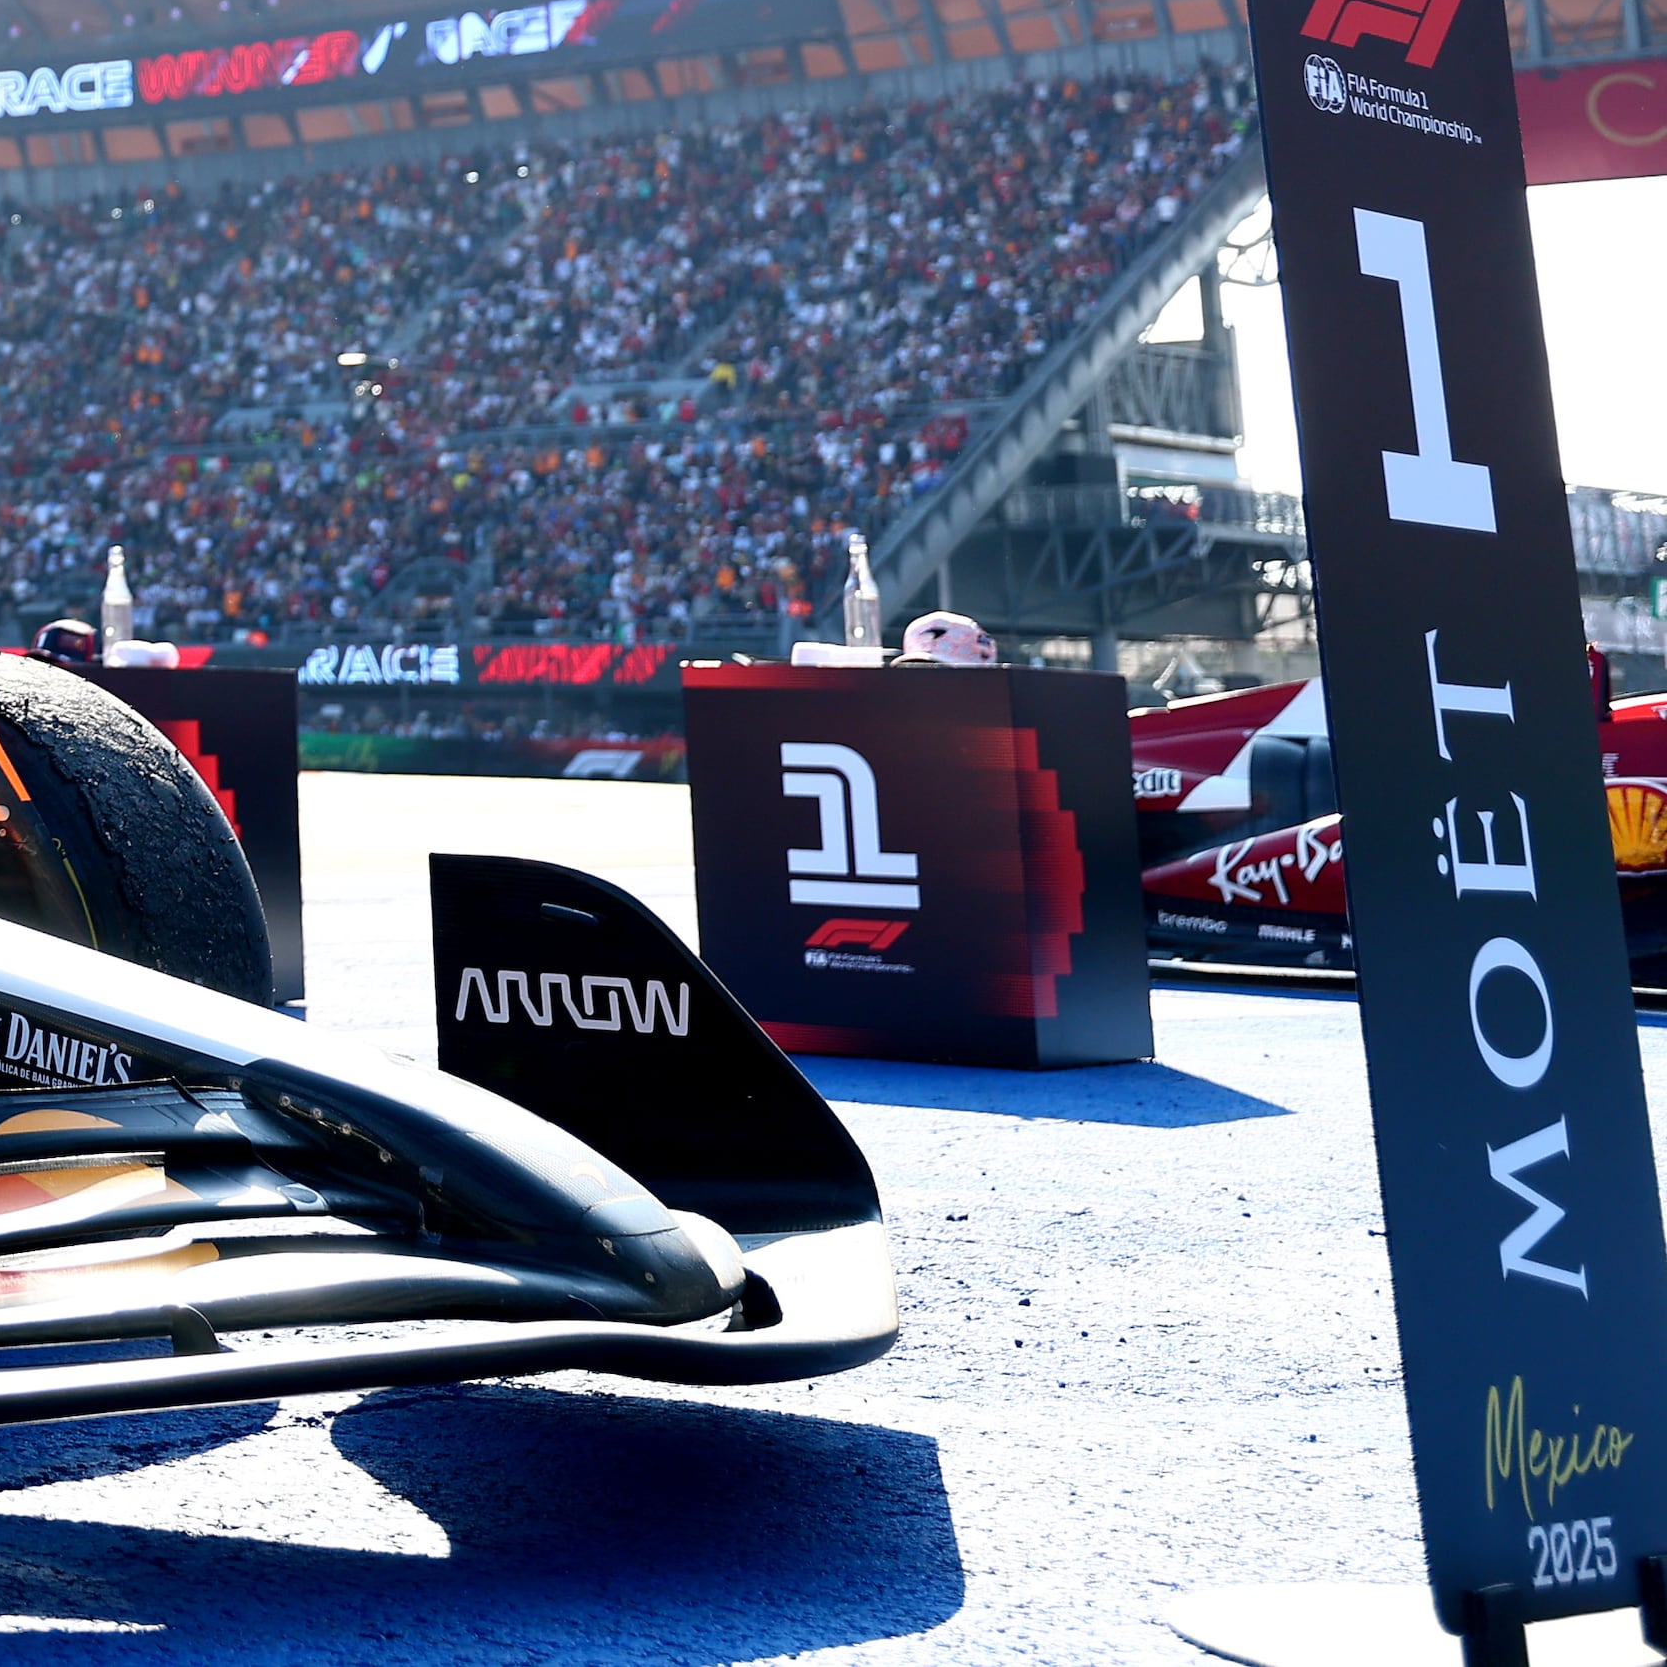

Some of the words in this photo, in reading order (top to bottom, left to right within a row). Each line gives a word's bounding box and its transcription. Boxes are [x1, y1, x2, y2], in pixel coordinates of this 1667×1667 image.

[137, 30, 360, 104] WINNER
[1347, 72, 1369, 98] FIA
[1369, 78, 1420, 110] Formula
[1419, 90, 1430, 111] 1
[1348, 94, 1388, 123] World
[1388, 104, 1474, 145] Championship
[1352, 206, 1498, 534] 1
[780, 742, 921, 910] 1
[1157, 909, 1229, 935] brembo
[1423, 627, 1589, 1302] MOËT
[455, 967, 690, 1037] ARROW
[4, 1011, 133, 1086] DANIEL'S
[20, 1067, 31, 1080] DE
[31, 1071, 51, 1086] BAJA
[1483, 1374, 1634, 1520] Mexico
[1527, 1515, 1619, 1591] 2025
